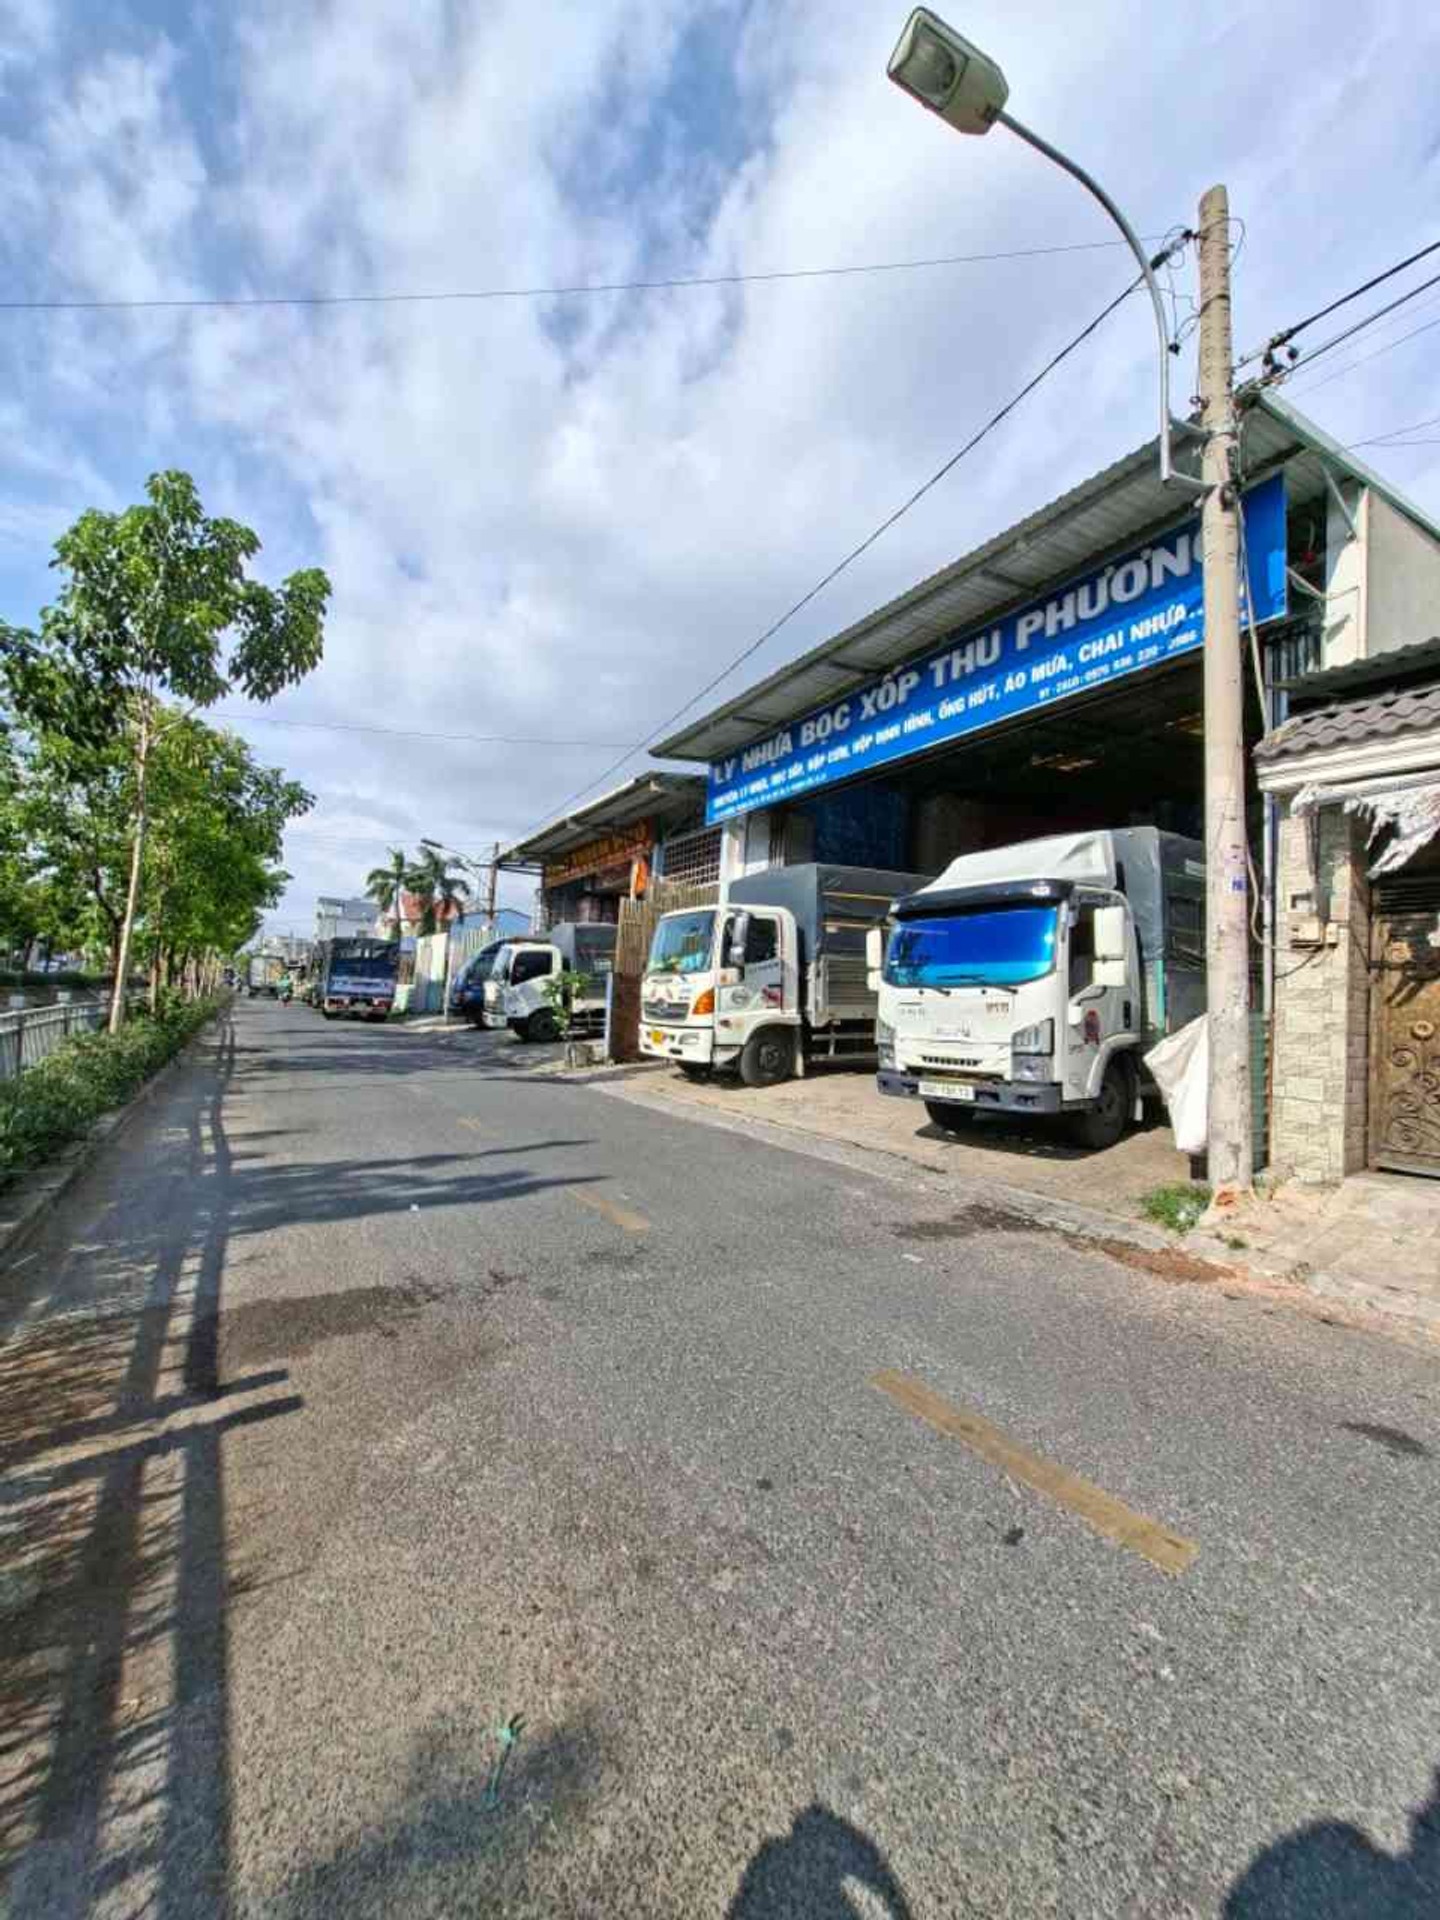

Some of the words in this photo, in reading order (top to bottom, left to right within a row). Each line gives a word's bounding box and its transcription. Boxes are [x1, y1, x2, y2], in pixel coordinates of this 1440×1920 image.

[742, 732, 793, 773] NHỰA
[801, 703, 850, 747] BỌC
[861, 664, 920, 721] XỐP
[930, 634, 1000, 689] THU
[1016, 530, 1204, 651] PHƯƠN
[938, 697, 965, 721] ỐNG
[968, 683, 1000, 708] HÚT,
[1004, 671, 1026, 693] ÁO
[1031, 652, 1073, 684] MƯA,
[1079, 629, 1124, 662] CHAI
